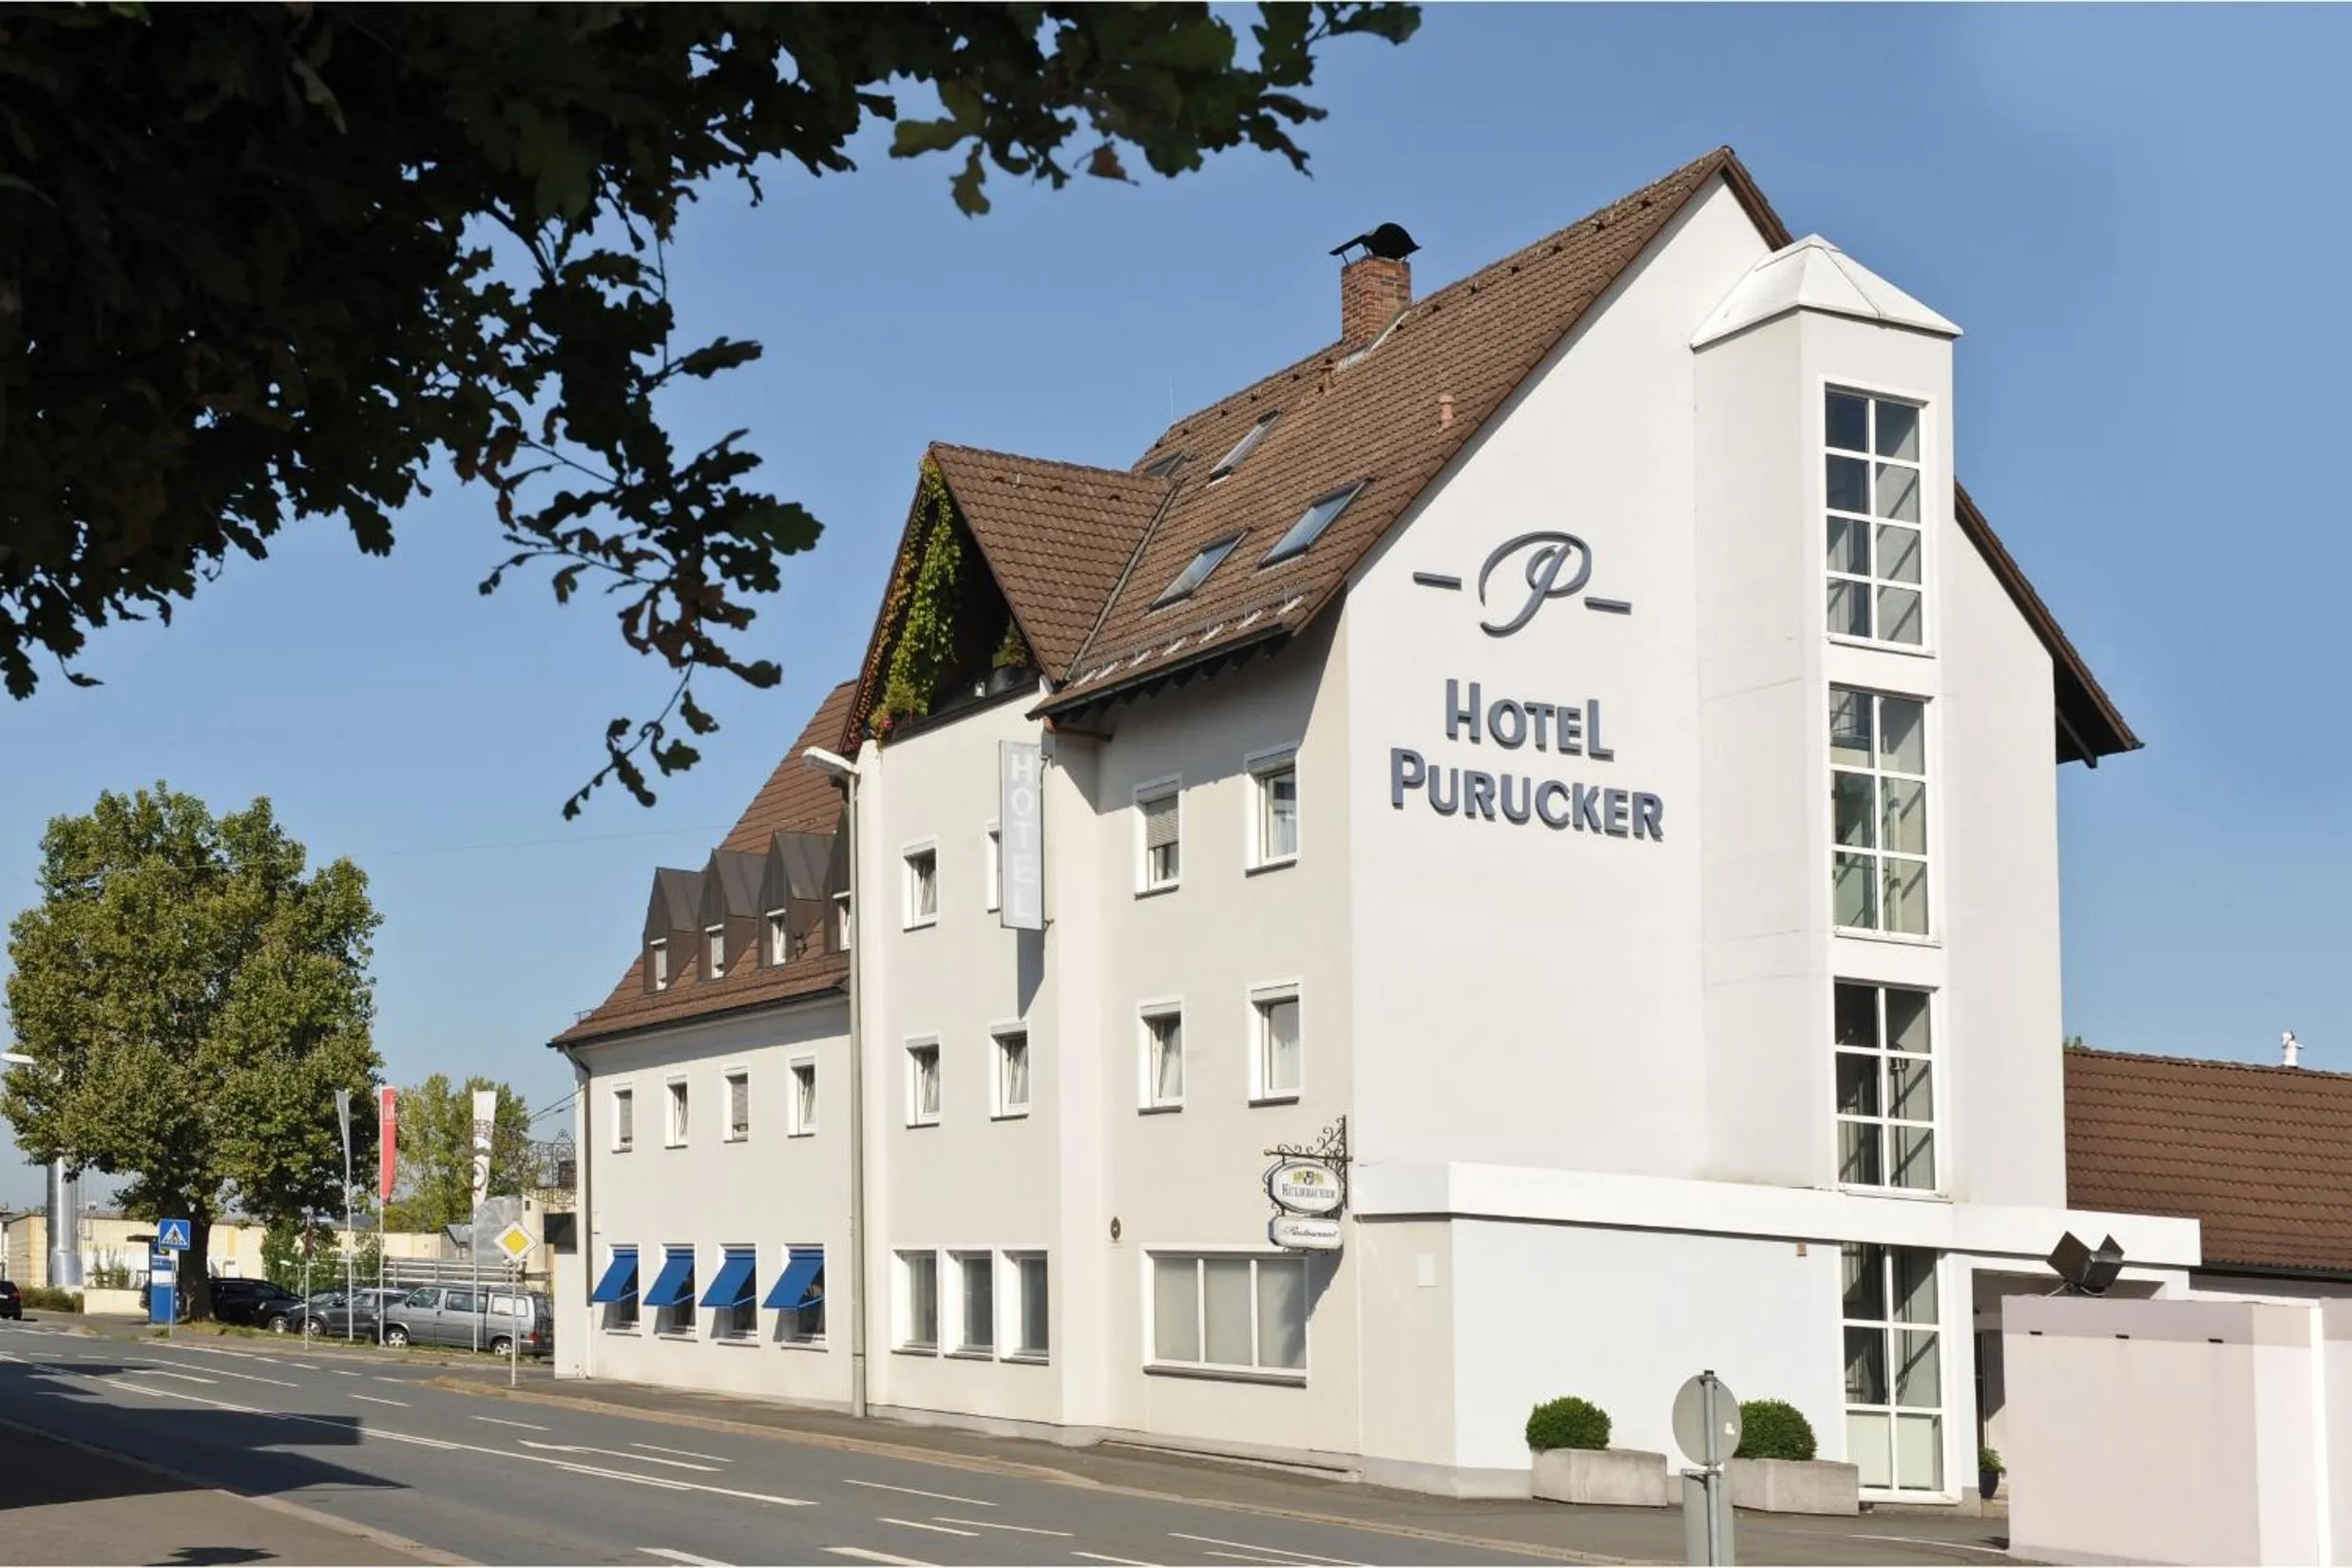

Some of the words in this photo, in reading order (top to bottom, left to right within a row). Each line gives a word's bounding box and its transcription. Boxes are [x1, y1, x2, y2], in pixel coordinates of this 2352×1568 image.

[1445, 678, 1615, 763] HOTEL
[1010, 752, 1036, 918] HOTEL
[1390, 747, 1664, 842] PURUCKER
